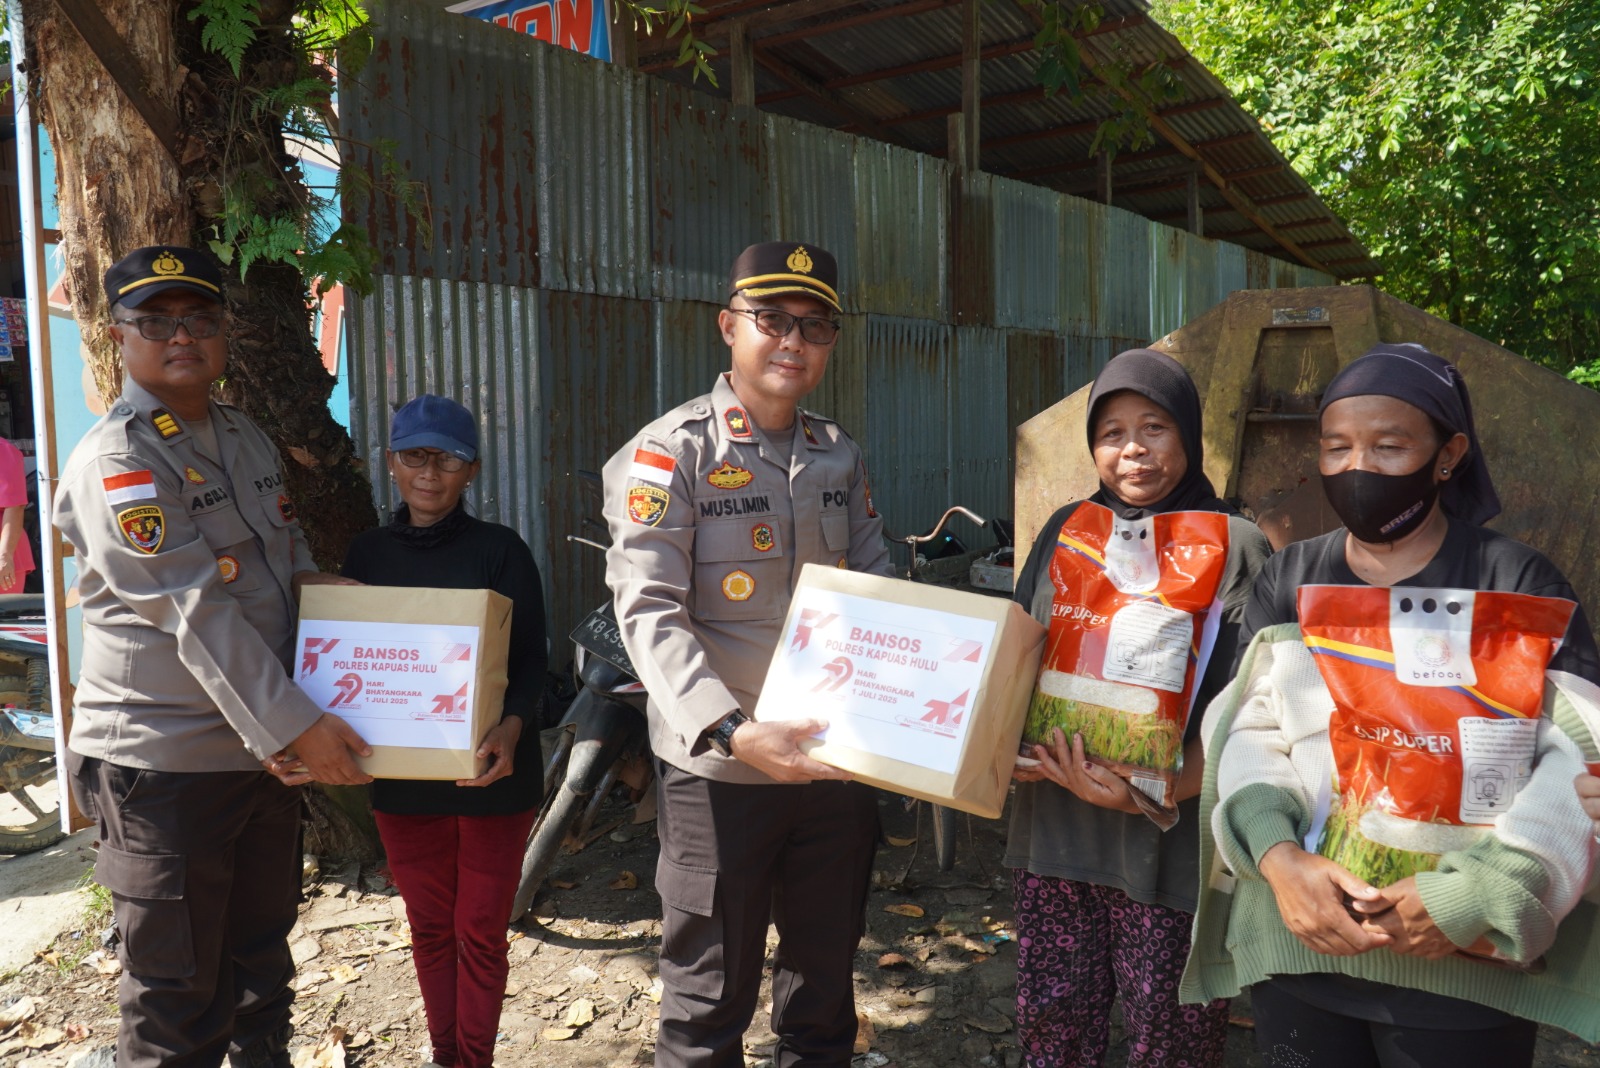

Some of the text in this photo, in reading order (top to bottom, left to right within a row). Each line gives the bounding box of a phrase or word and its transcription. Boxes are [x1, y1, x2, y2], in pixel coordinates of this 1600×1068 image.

[632, 488, 665, 498] LOGISTIK
[822, 490, 848, 508] POL
[122, 508, 160, 520] LOGISTIK
[700, 496, 771, 517] MUSLIMIN
[849, 626, 922, 653] BANSOS
[353, 646, 420, 661] BANSOS
[825, 639, 938, 672] POLRES KAPUAS HULU
[333, 660, 437, 674] POLRES KAPUAS HULU
[856, 668, 877, 680] HARI
[365, 688, 423, 697] BHAYANGKARA
[853, 678, 915, 699] BHAYANGKARA
[858, 689, 876, 700] JULI
[877, 693, 897, 704] 2025
[1392, 729, 1453, 753] SUPER
